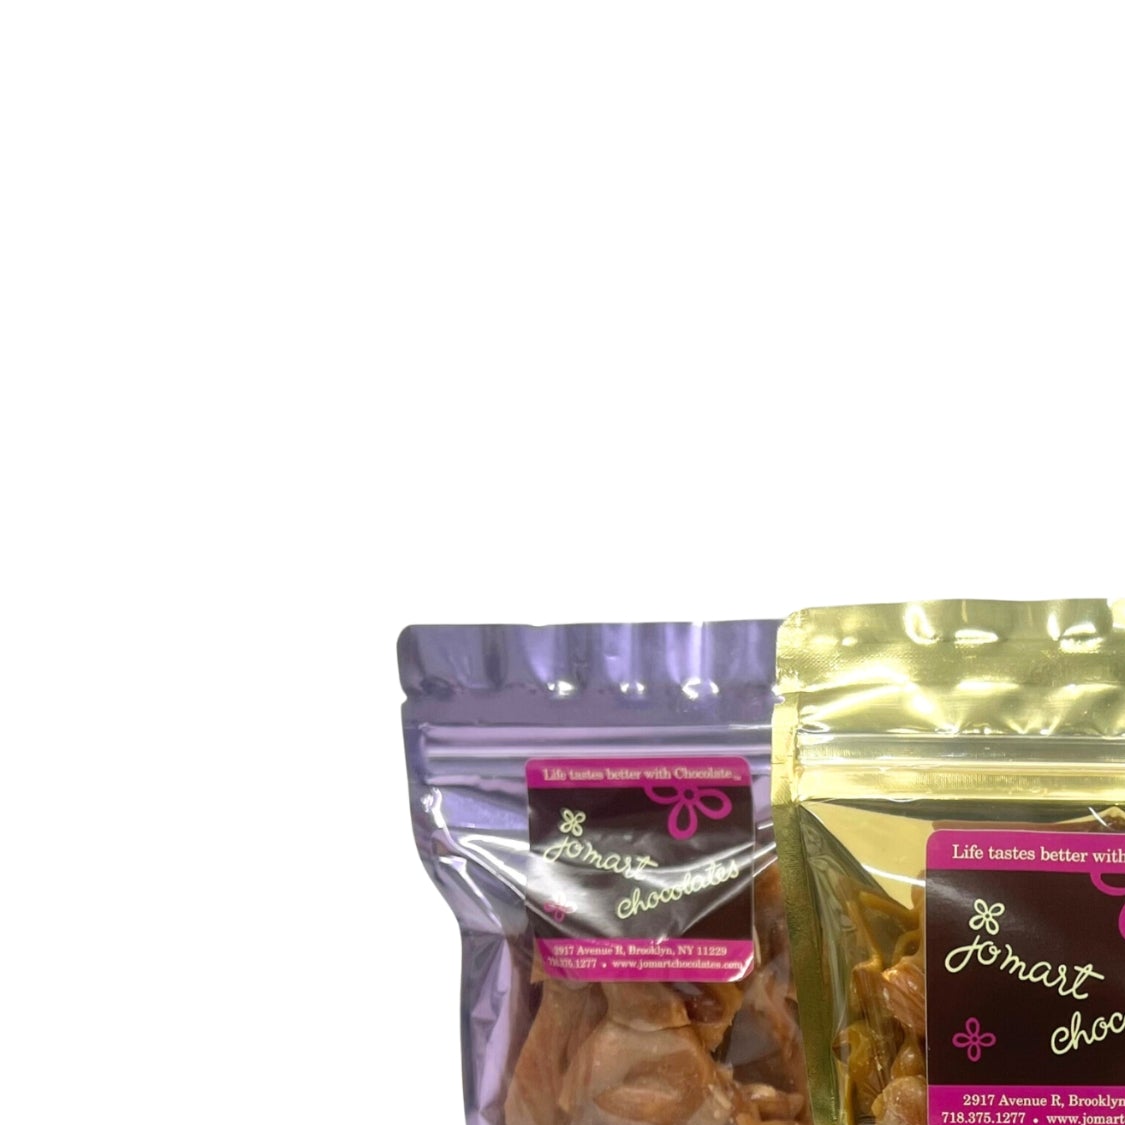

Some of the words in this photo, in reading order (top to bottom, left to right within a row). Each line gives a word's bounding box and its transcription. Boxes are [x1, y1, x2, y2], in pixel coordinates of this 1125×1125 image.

[570, 770, 604, 780] tastes
[606, 767, 640, 780] better
[644, 766, 671, 780] with
[952, 844, 983, 860] Life
[988, 846, 1035, 860] tastes
[1040, 846, 1088, 862] better
[616, 858, 739, 919] chocolates
[576, 945, 613, 955] Avenue
[677, 945, 694, 955] NY
[697, 945, 727, 956] 11229
[963, 1094, 995, 1107] 2917
[998, 1094, 1047, 1107] Avenue
[1050, 1095, 1065, 1109] R,
[941, 1111, 1026, 1124] 718.375.1277
